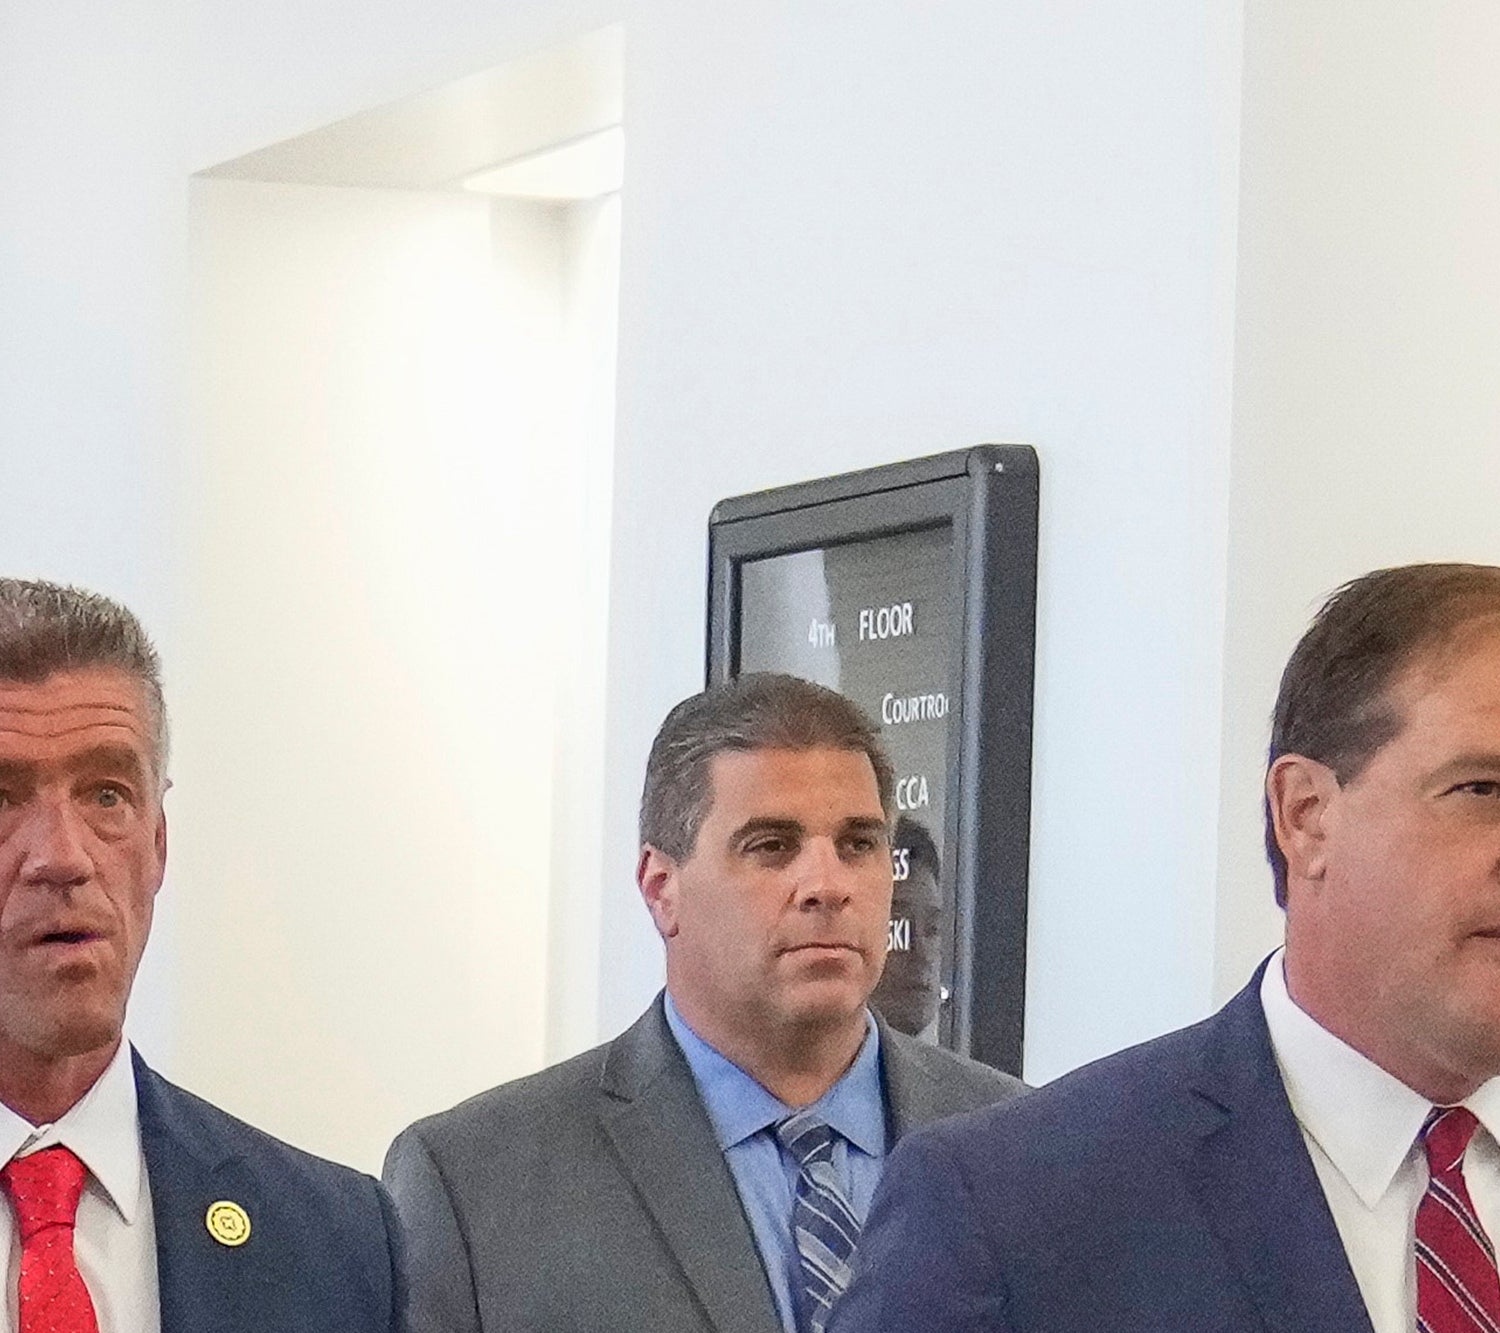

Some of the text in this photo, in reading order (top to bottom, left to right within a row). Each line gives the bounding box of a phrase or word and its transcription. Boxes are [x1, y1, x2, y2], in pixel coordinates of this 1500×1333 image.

[808, 602, 913, 648] 4TH FLOOR
[882, 692, 949, 725] COURTRO
